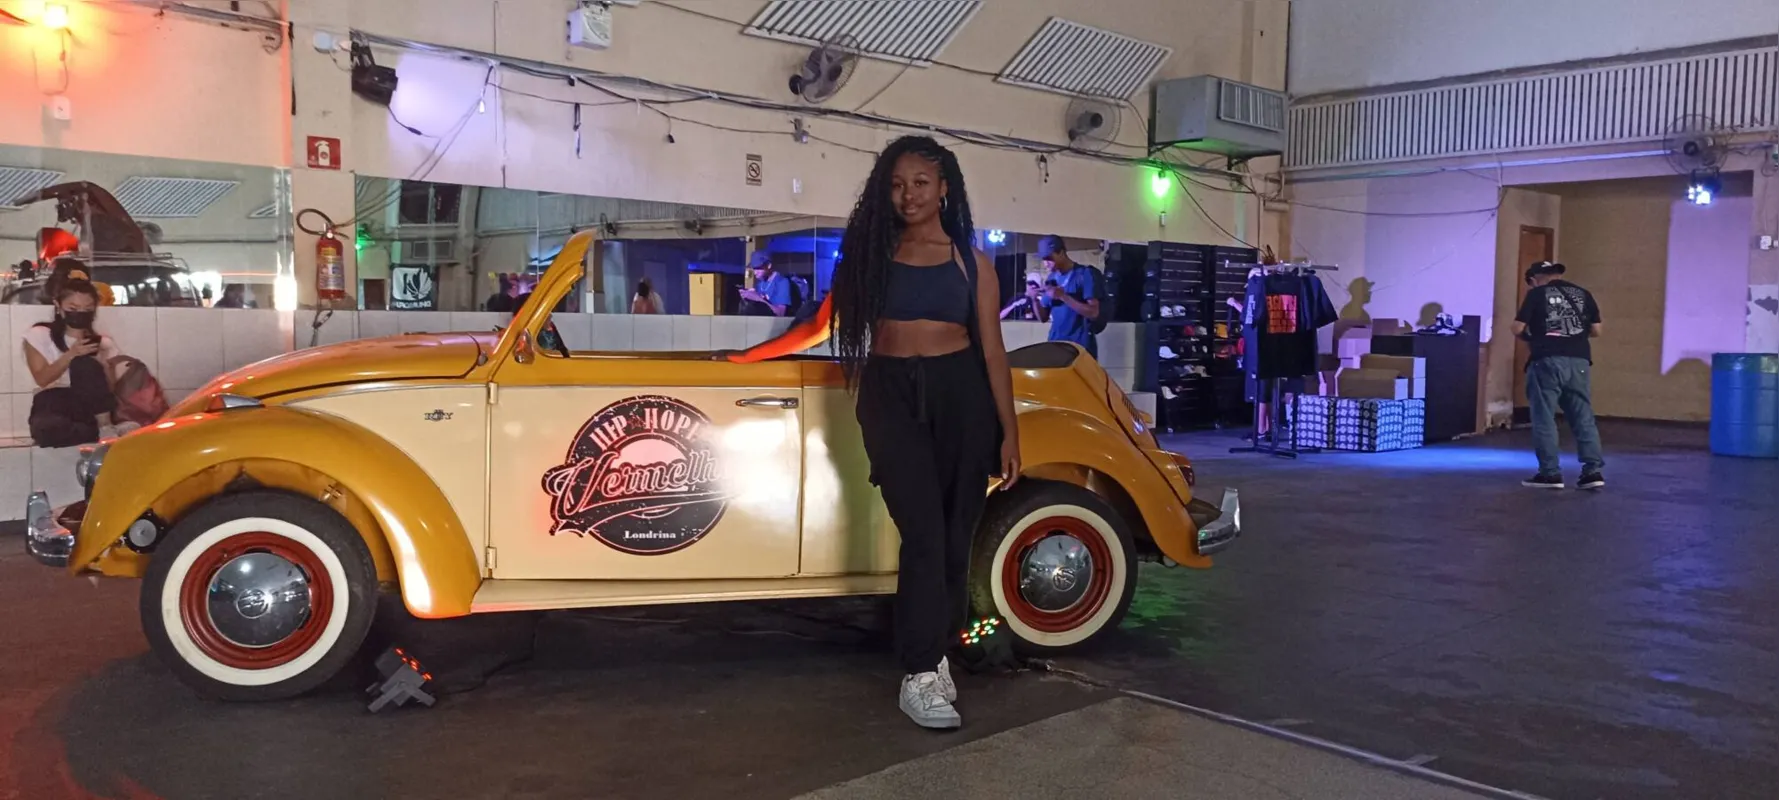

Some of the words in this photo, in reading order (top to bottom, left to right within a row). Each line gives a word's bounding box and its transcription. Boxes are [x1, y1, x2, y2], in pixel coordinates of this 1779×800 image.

[589, 415, 628, 452] HIP
[546, 449, 730, 517] Vermelh
[623, 530, 677, 539] Londrina
